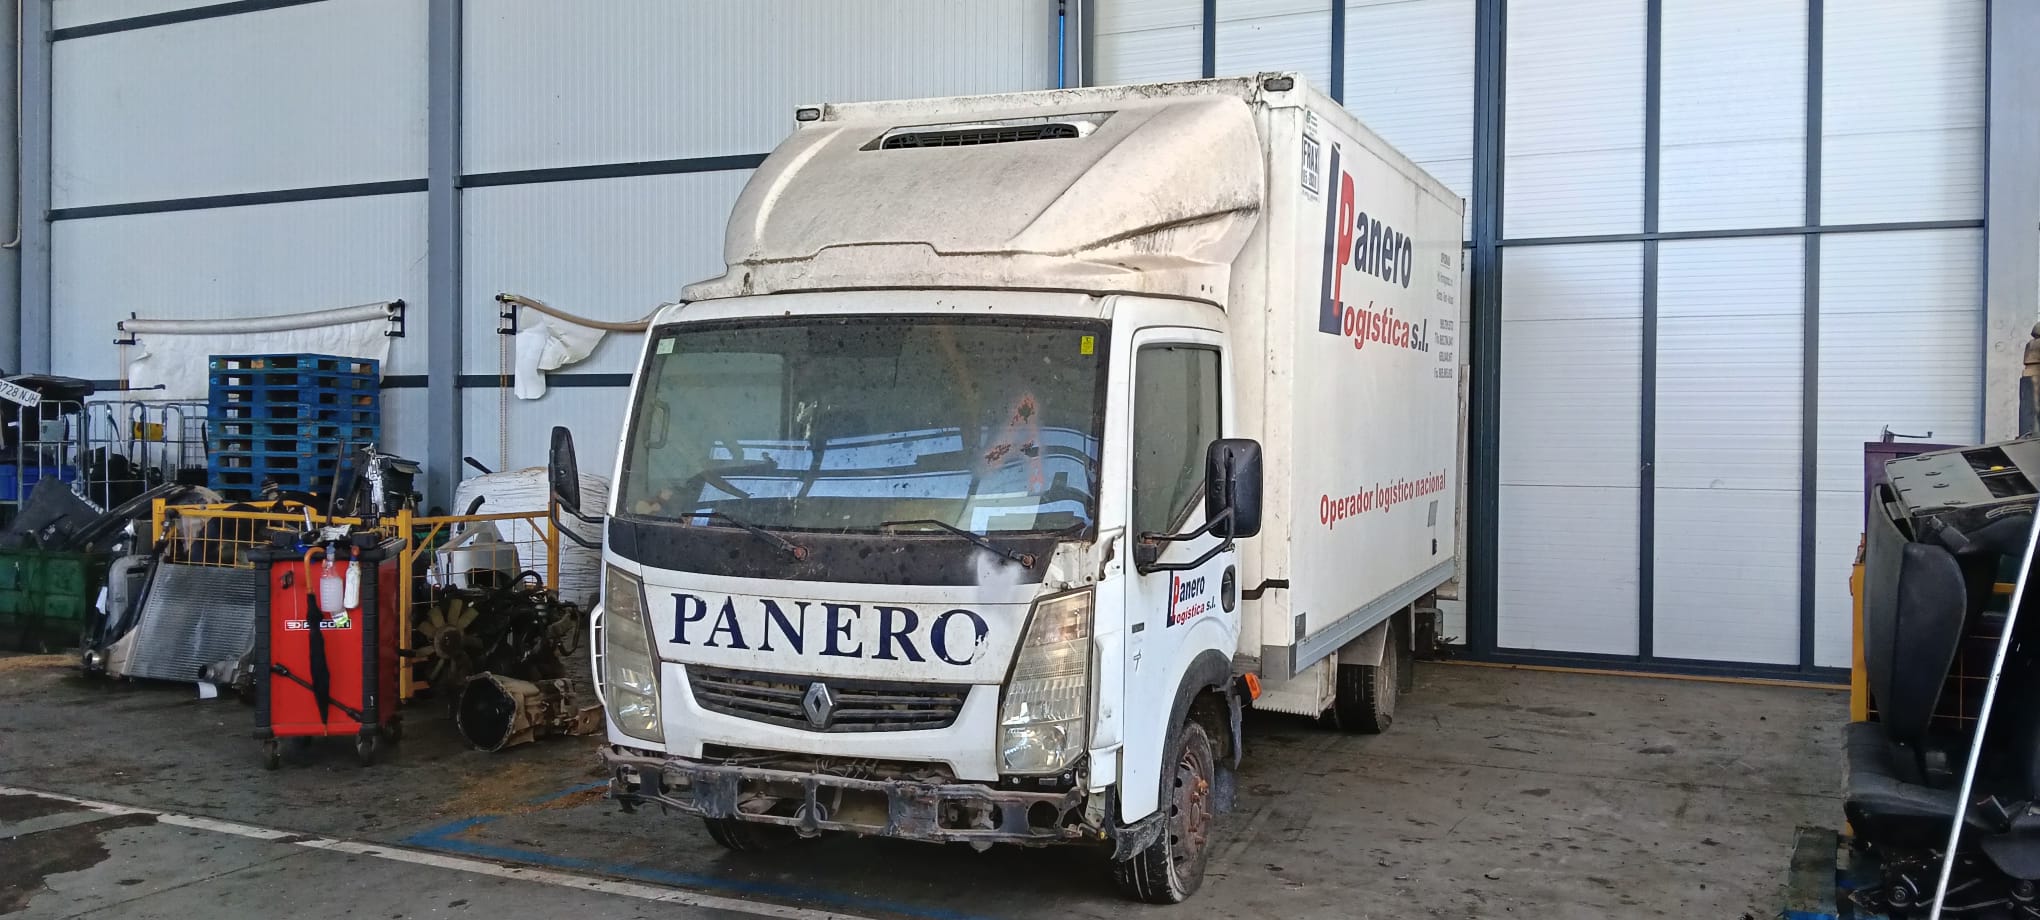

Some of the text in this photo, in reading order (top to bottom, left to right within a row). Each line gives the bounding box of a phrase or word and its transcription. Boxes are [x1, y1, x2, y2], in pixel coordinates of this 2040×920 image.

[1303, 140, 1318, 172] FRAX
[1333, 170, 1412, 316] Panero
[1411, 318, 1429, 353] s.l.
[19, 390, 38, 405] NJH
[1320, 486, 1374, 530] Operador
[1415, 468, 1446, 498] nacional
[668, 592, 989, 666] PANERO
